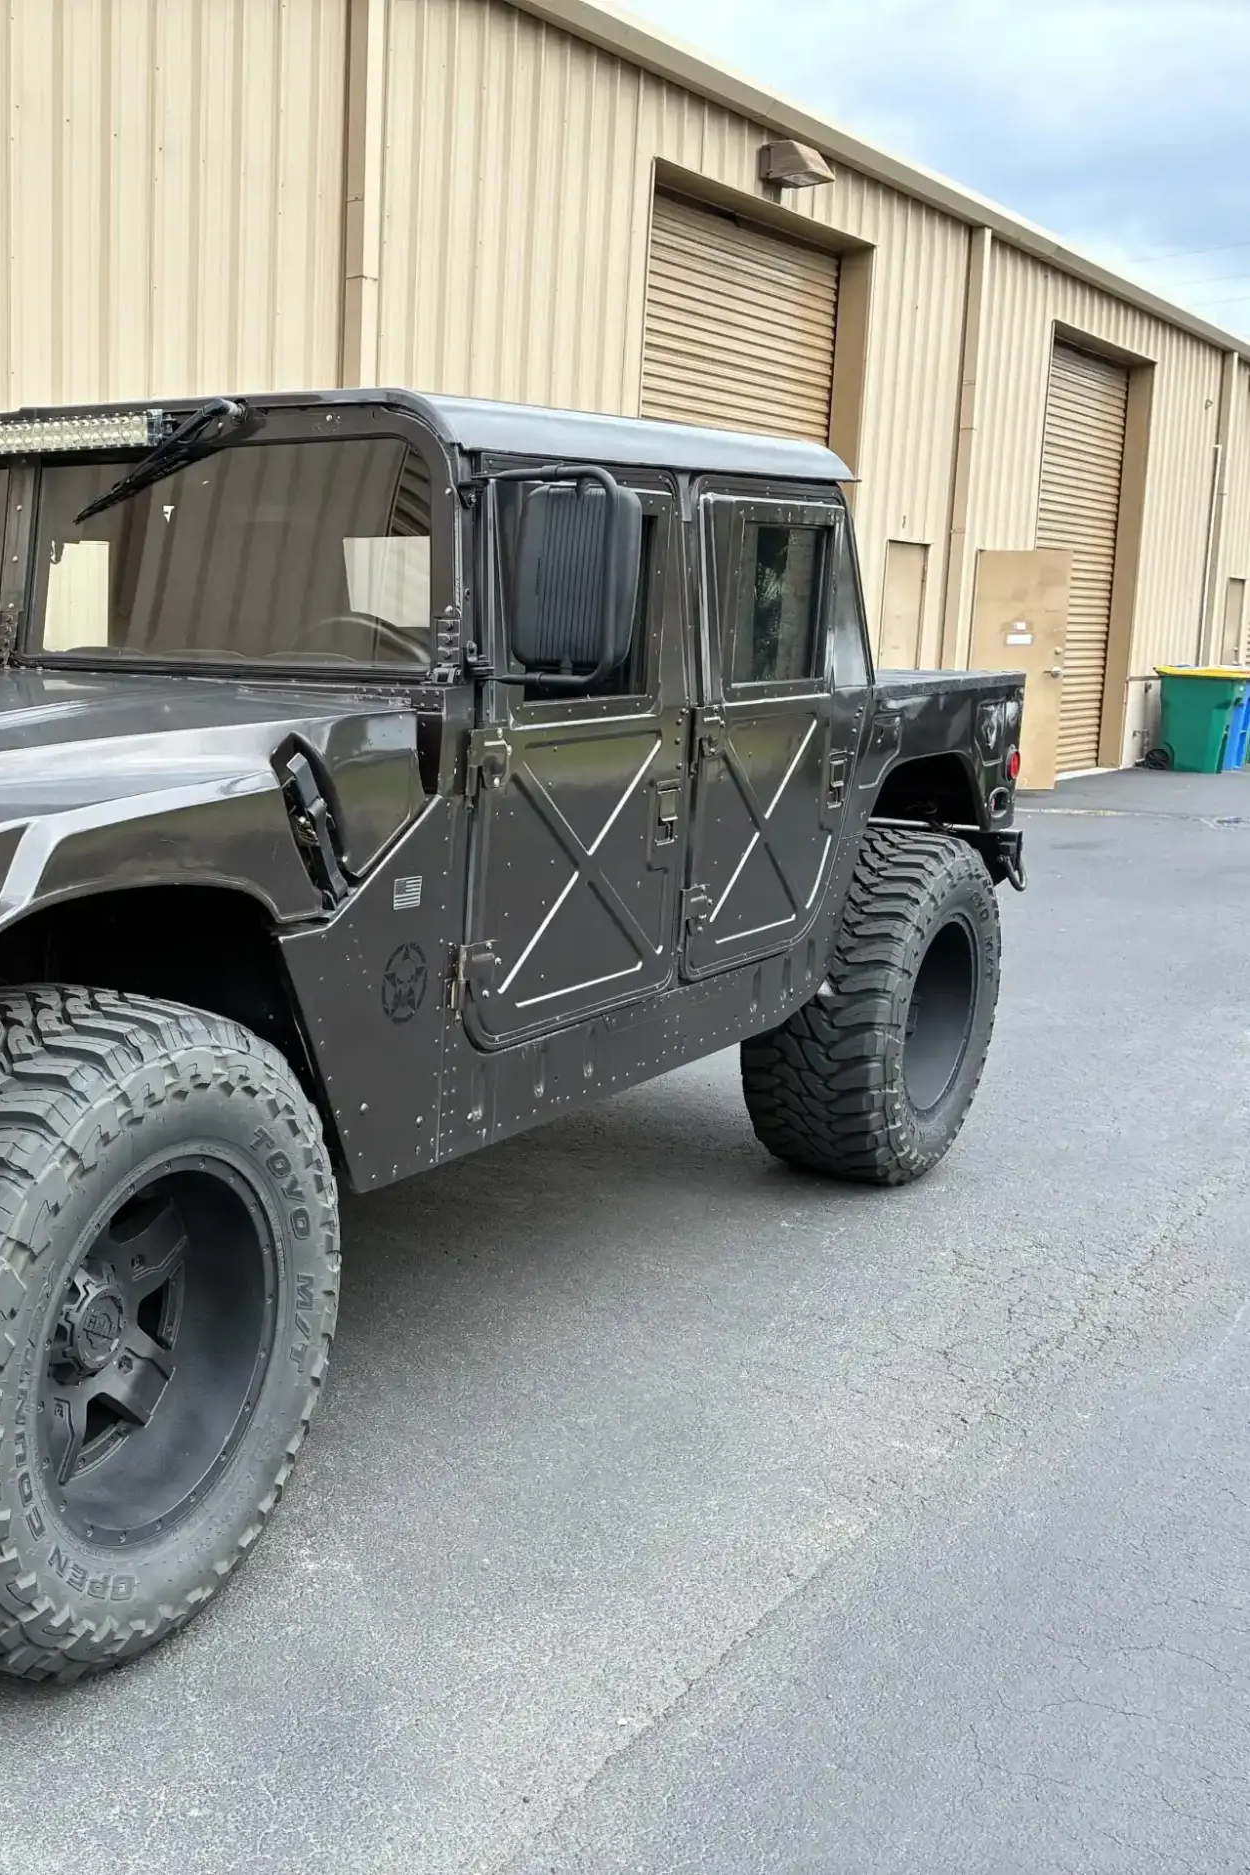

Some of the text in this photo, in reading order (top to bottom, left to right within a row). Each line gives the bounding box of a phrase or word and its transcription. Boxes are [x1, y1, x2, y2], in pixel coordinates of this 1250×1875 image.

[250, 1125, 311, 1241] TOYO
[290, 1273, 315, 1374] M/T
[47, 1542, 135, 1601] OPEN
